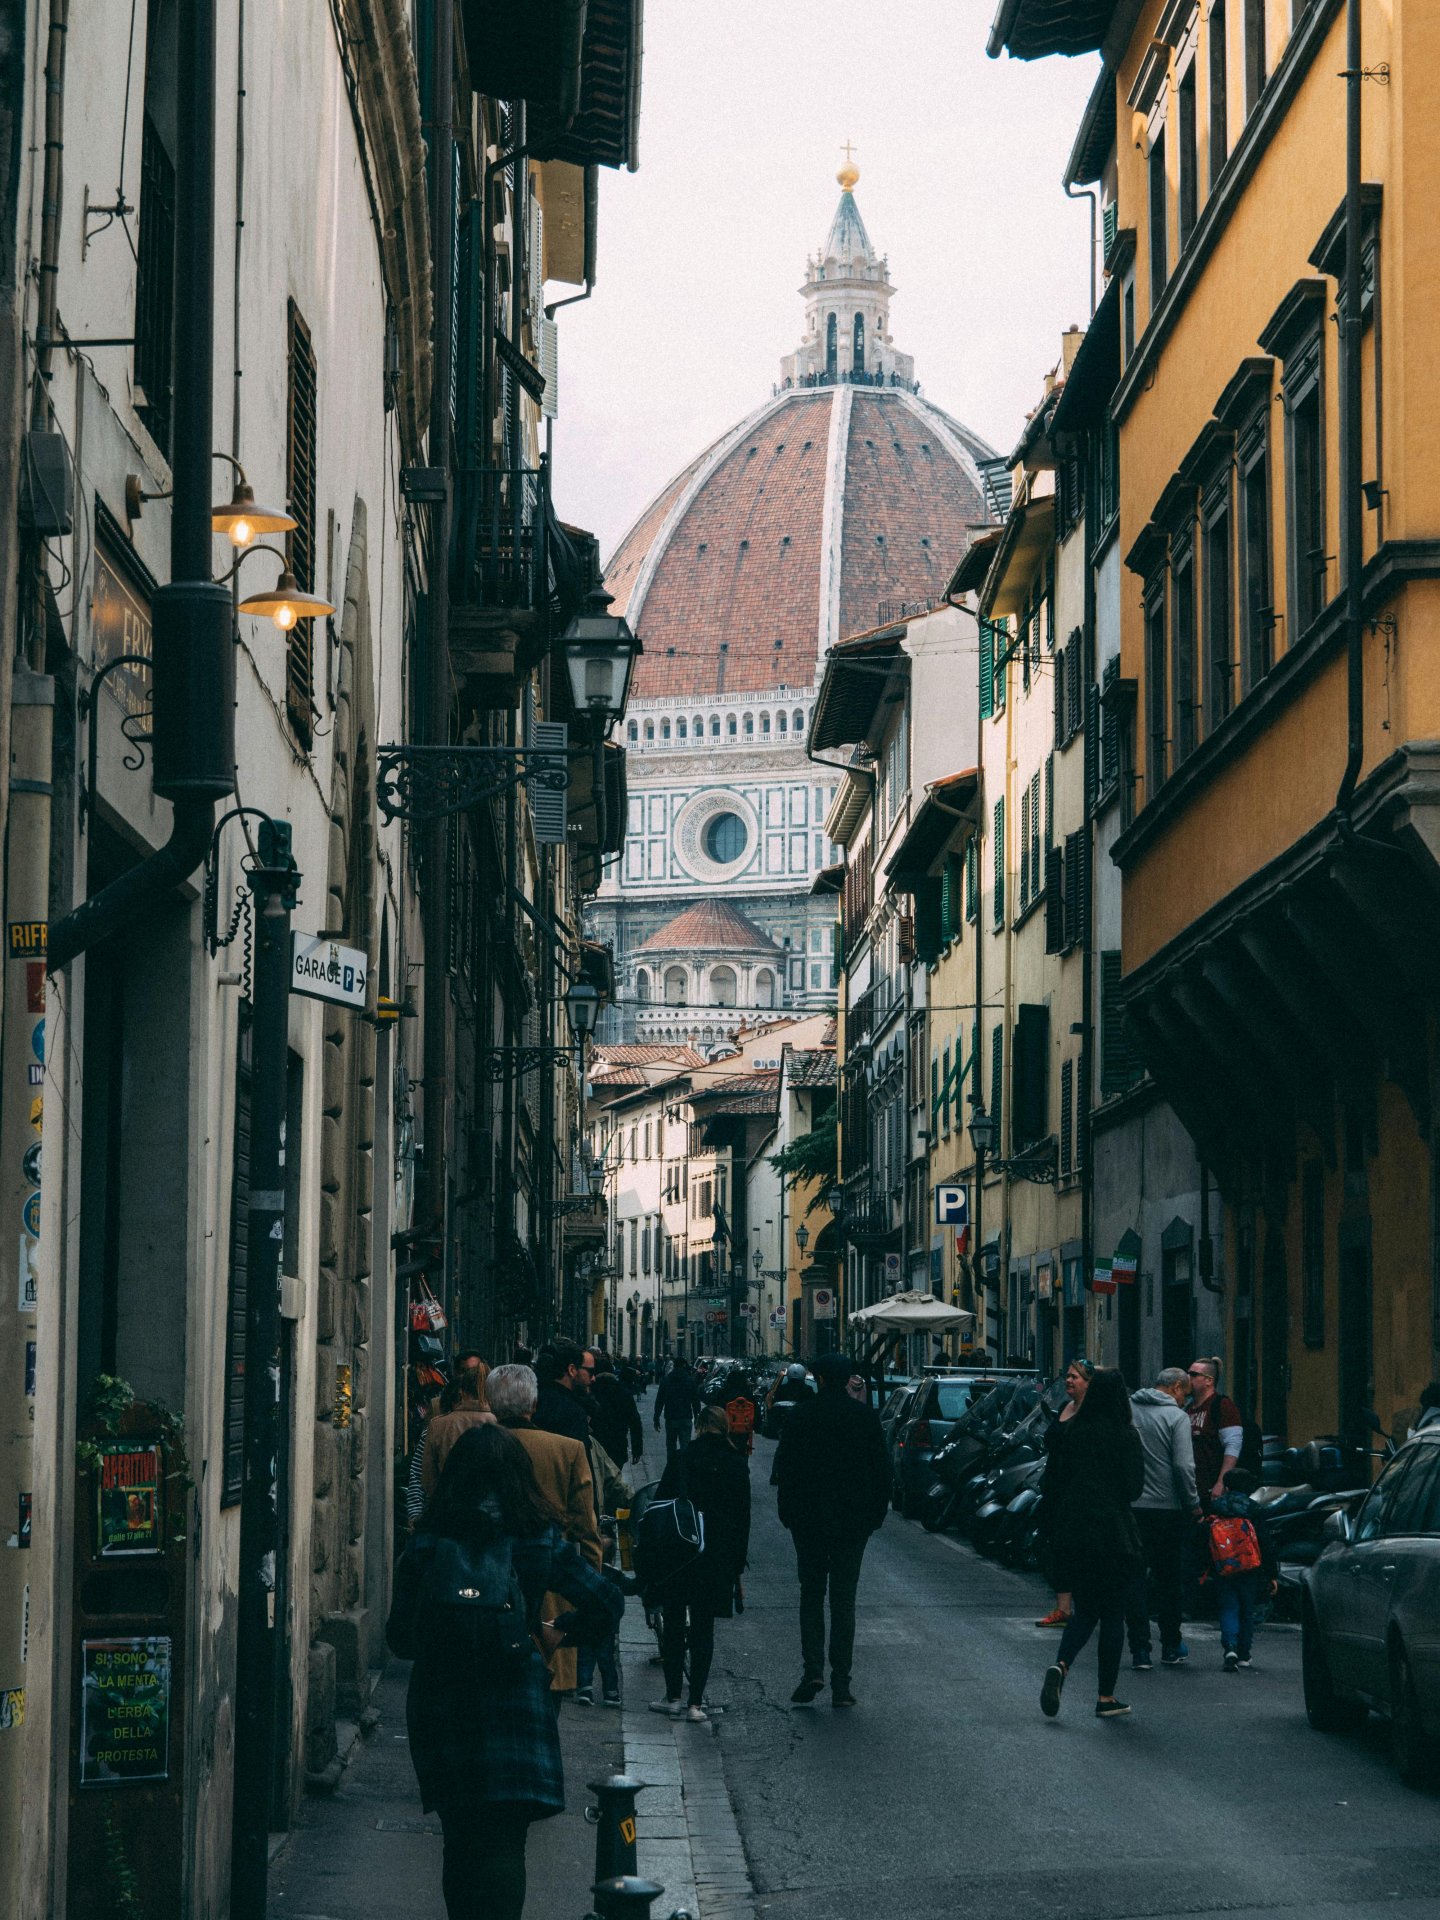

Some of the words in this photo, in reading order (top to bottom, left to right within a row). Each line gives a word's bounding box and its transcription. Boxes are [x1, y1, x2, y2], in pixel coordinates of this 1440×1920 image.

[296, 954, 342, 985] GARAGE
[939, 1187, 965, 1222] P
[114, 1652, 148, 1665] SONO
[98, 1675, 114, 1688] LA
[107, 1706, 151, 1719] L'ERBA
[114, 1727, 152, 1739] DELLA
[96, 1748, 158, 1762] PROTESTA
